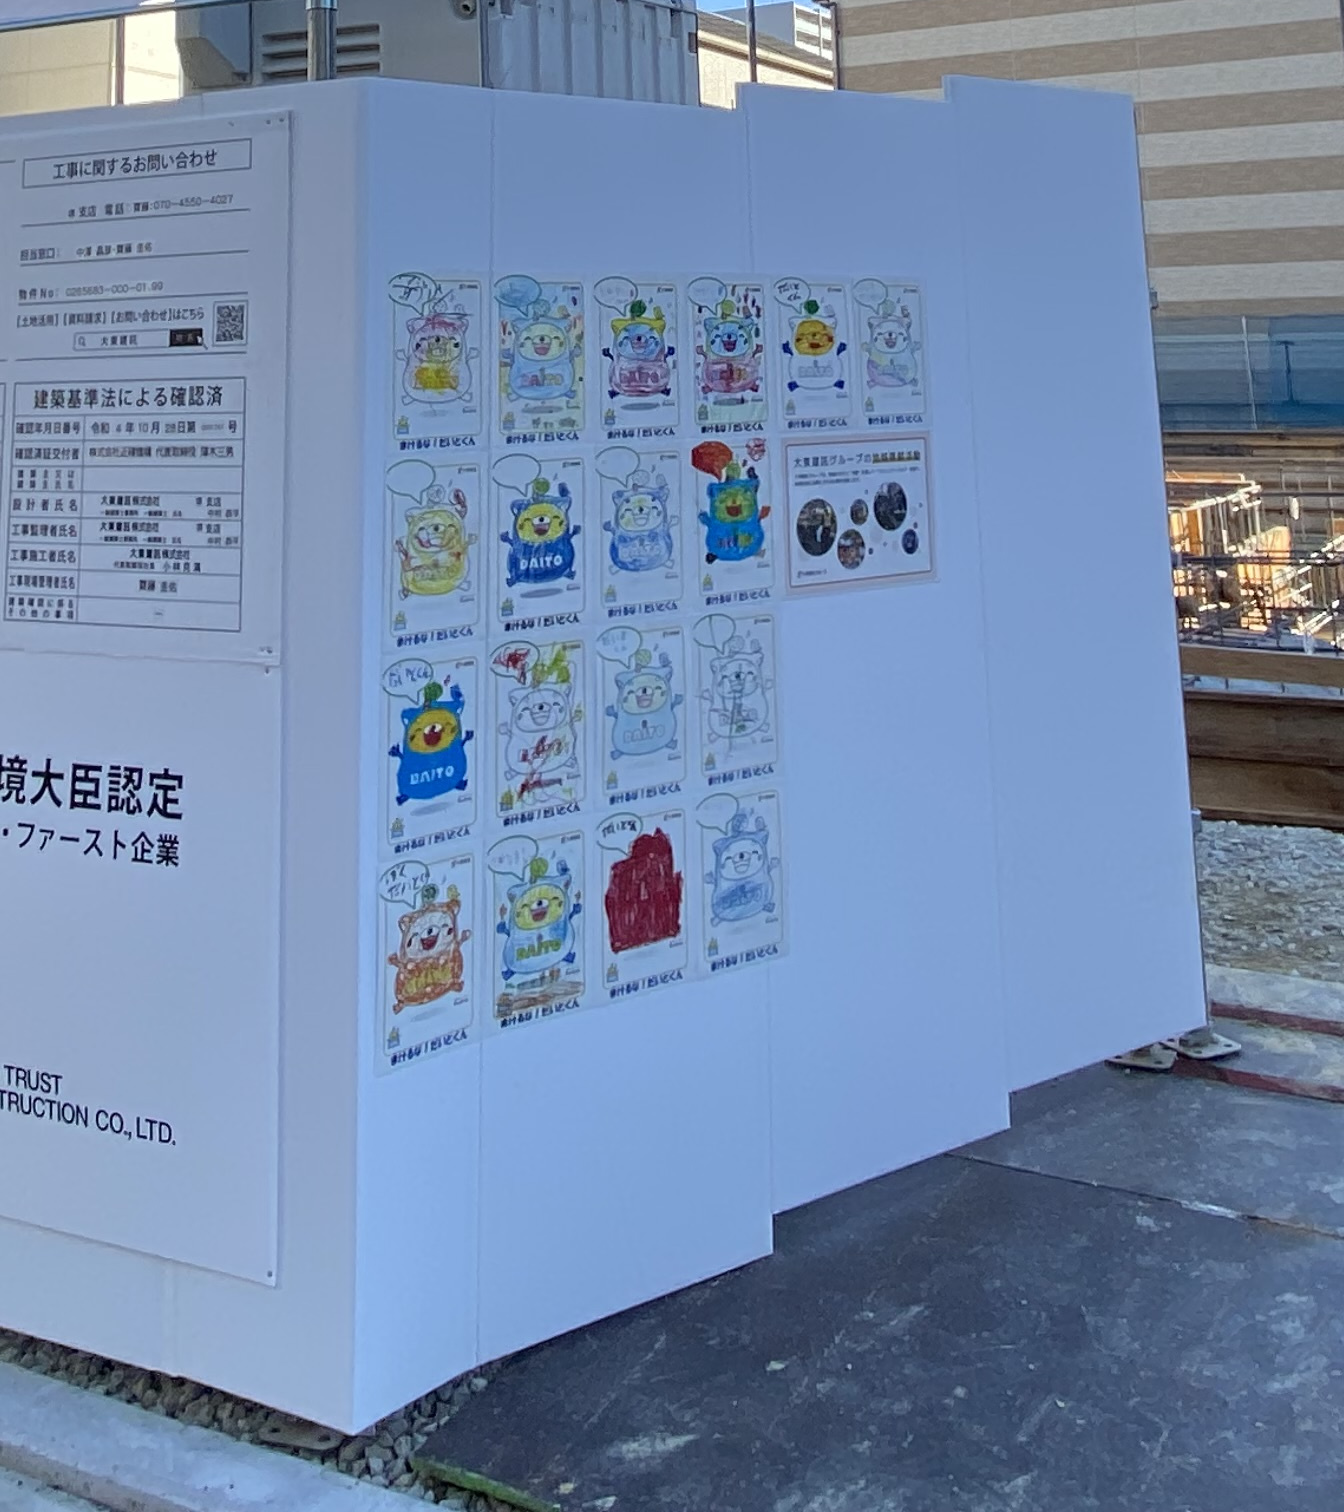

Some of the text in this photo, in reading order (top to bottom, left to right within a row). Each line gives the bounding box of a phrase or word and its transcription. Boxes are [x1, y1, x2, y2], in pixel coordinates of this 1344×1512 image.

[53, 149, 218, 179] 工事に関するお問い合わせ
[33, 386, 223, 409] 建築基準法による確認済
[12, 498, 78, 512] 設計者氏名
[520, 554, 564, 570] DAITO
[409, 764, 455, 786] DAITO
[515, 939, 562, 962] DAITO
[4, 1064, 63, 1096] TRUST
[136, 1116, 177, 1146] LTD.
